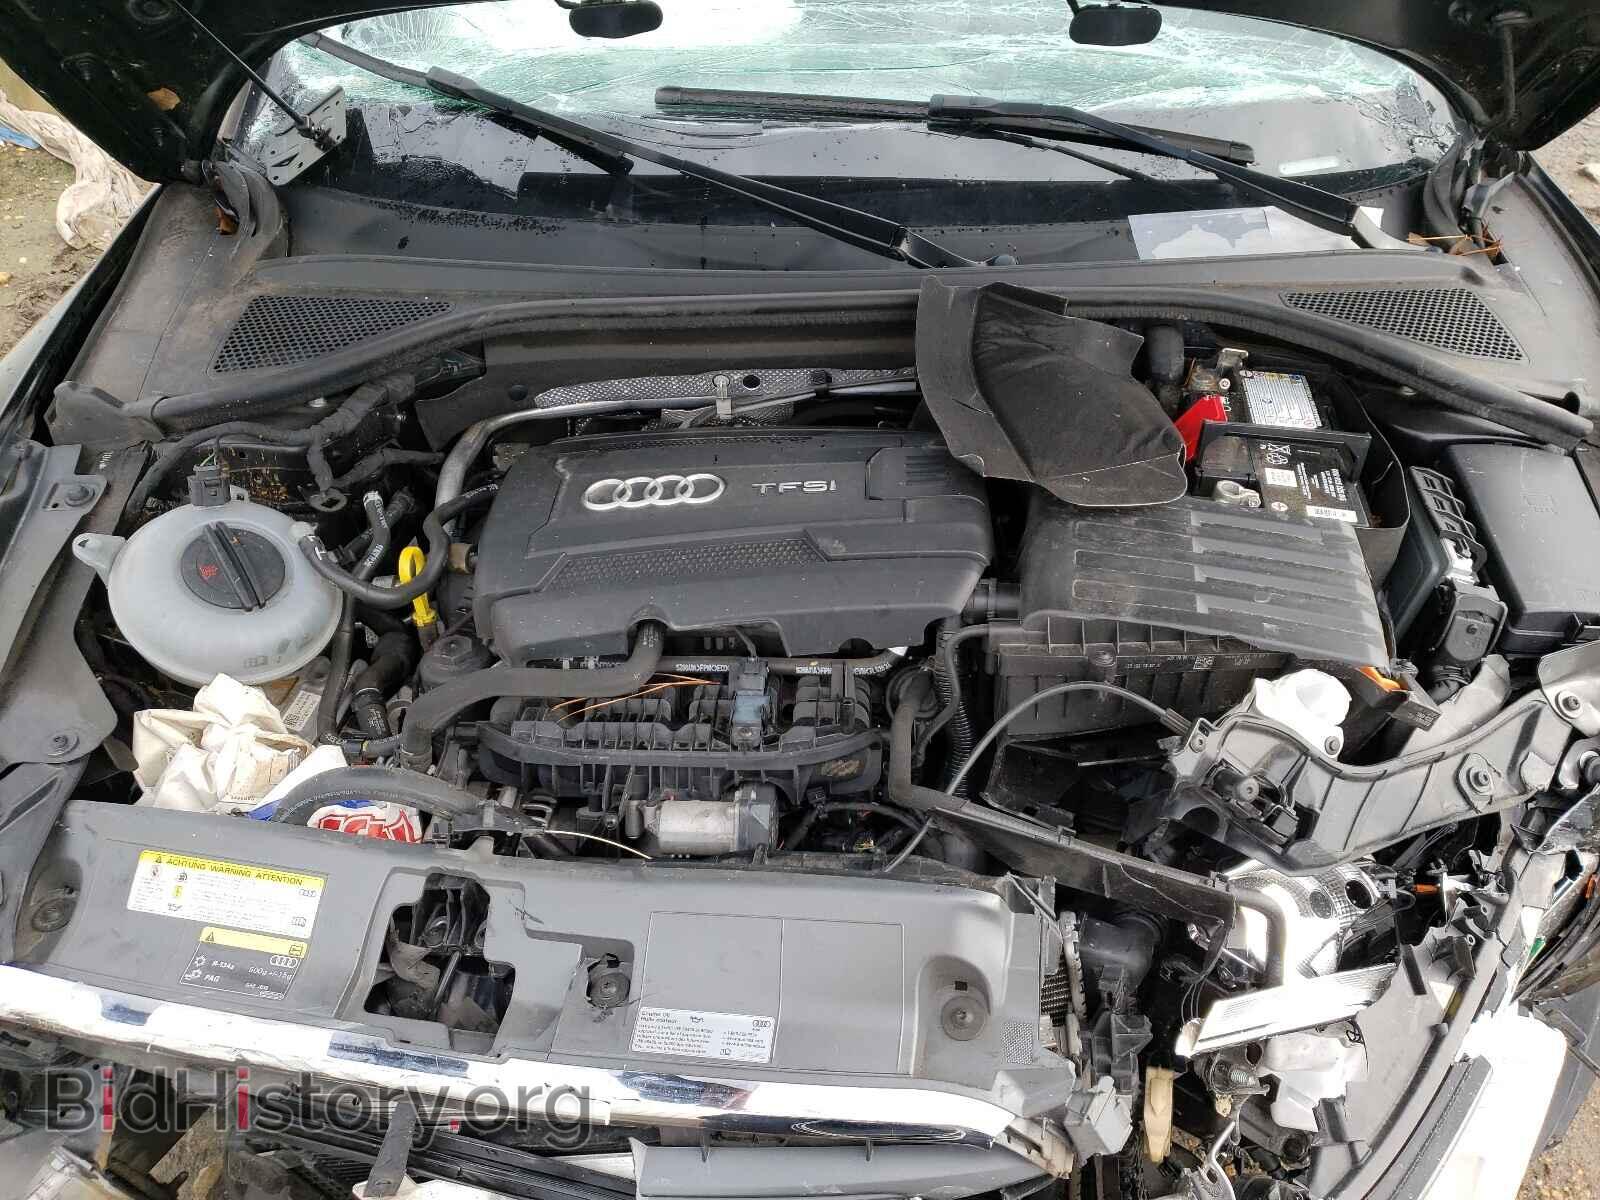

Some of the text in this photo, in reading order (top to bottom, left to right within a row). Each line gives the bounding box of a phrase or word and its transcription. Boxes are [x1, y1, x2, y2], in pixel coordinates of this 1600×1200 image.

[165, 857, 303, 886] ACHTUNG WARNING ATTENTION
